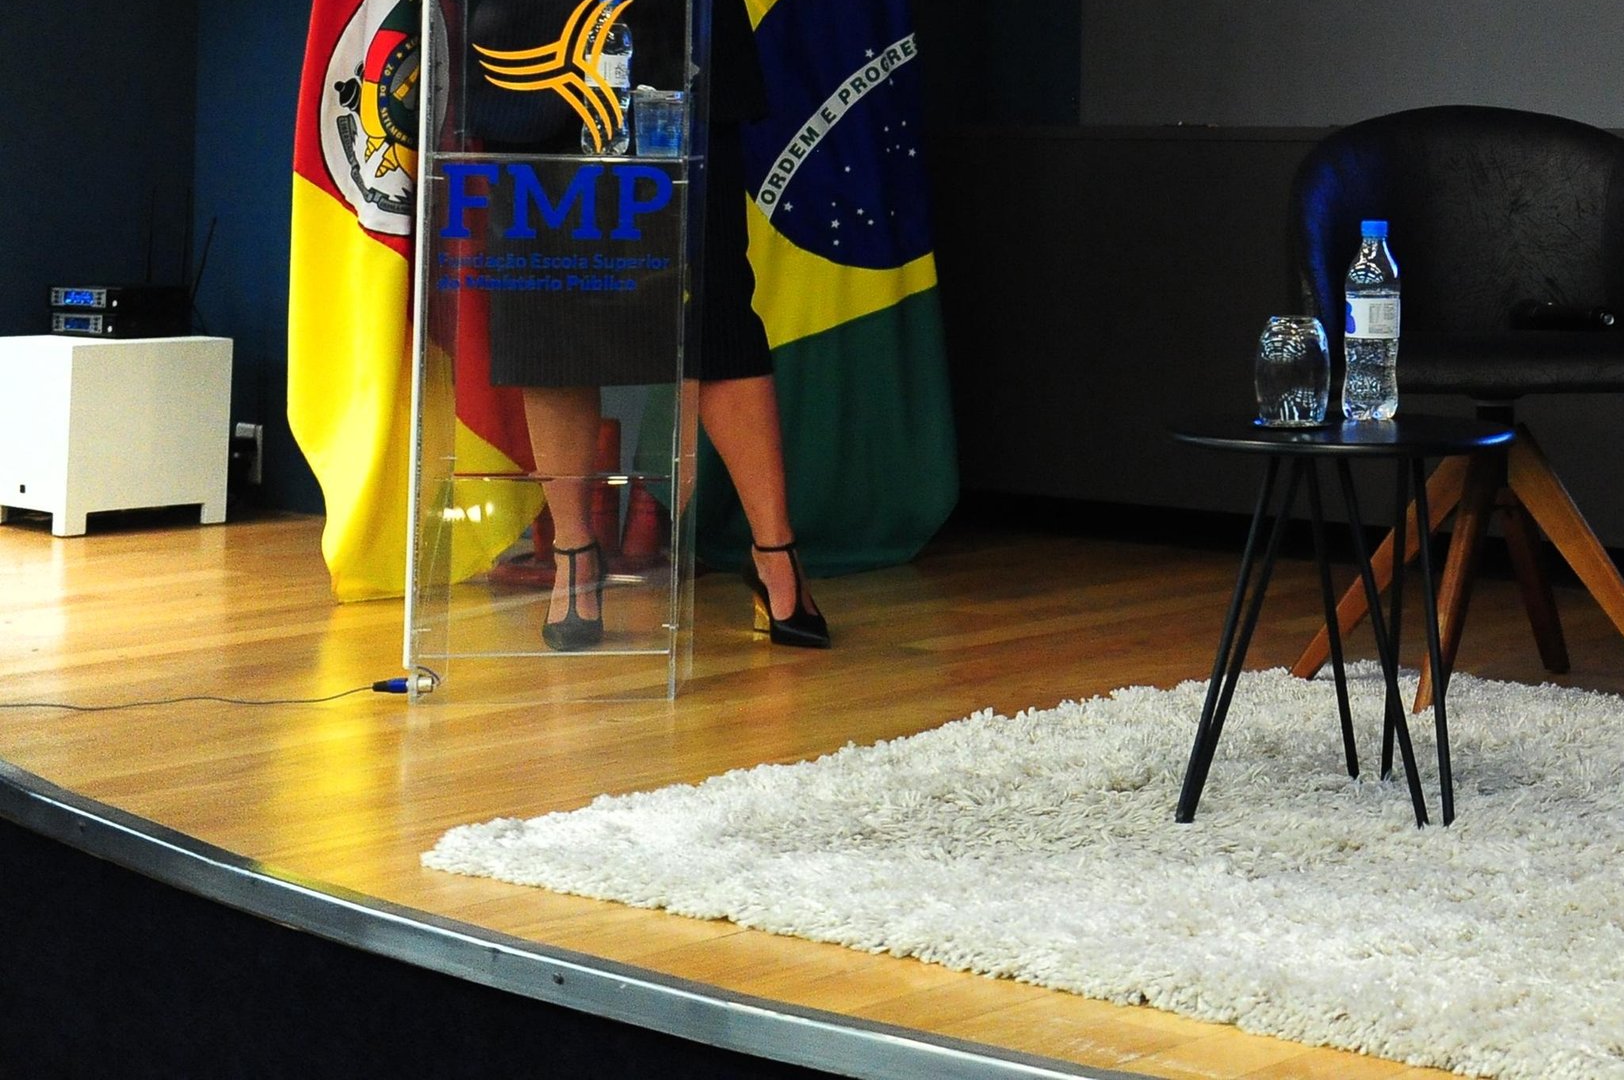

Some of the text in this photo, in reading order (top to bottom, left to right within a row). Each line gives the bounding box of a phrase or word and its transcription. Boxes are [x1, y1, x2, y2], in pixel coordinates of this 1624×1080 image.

[760, 125, 820, 205] ORDEM
[820, 107, 837, 124] E
[439, 162, 674, 240] FMP
[530, 252, 589, 270] Escola
[592, 252, 670, 272] Superior
